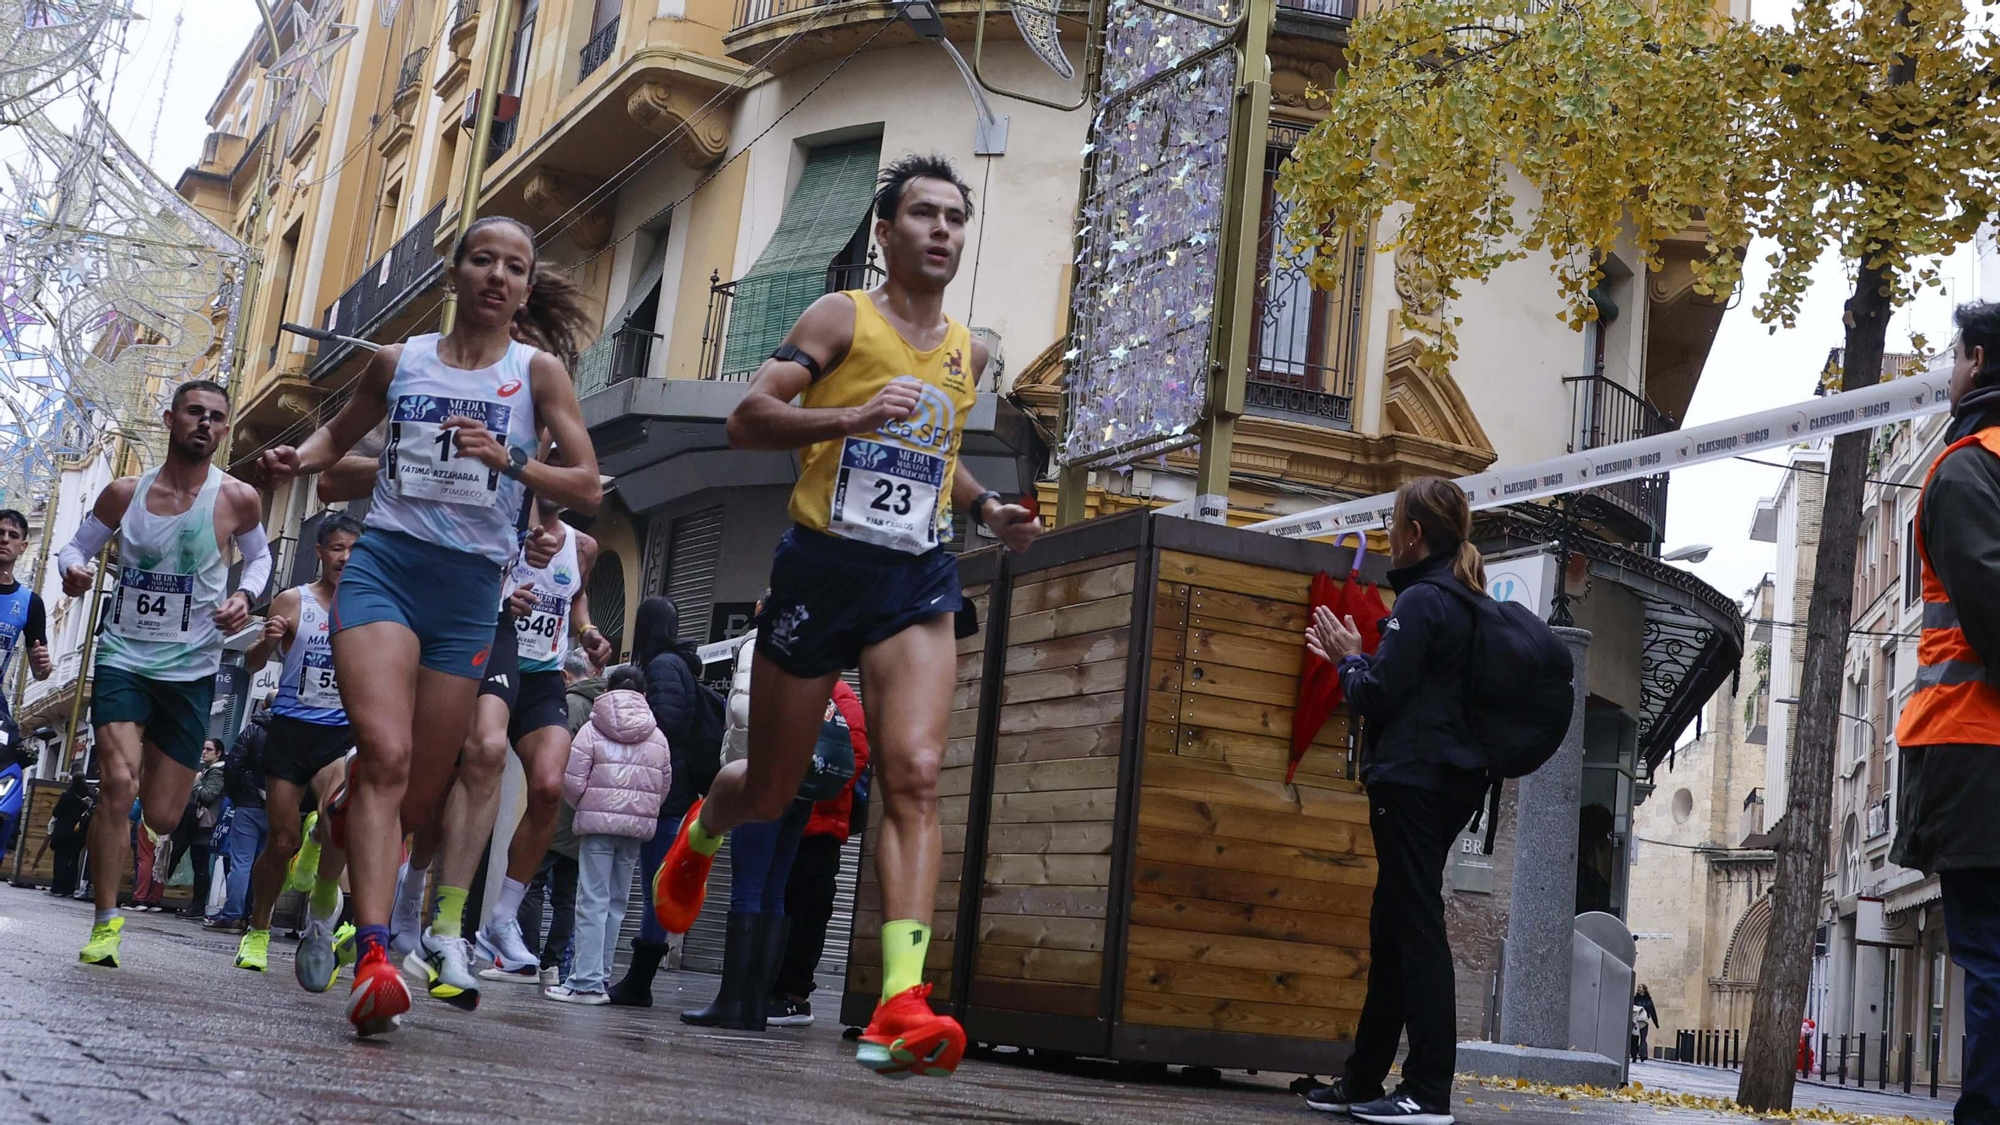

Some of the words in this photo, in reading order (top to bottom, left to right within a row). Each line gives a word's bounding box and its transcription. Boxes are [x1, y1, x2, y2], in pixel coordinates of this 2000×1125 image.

[400, 464, 432, 476] FÁTIMA
[432, 469, 480, 483] AZZAHARAA
[870, 478, 912, 516] 23
[136, 593, 167, 617] 64
